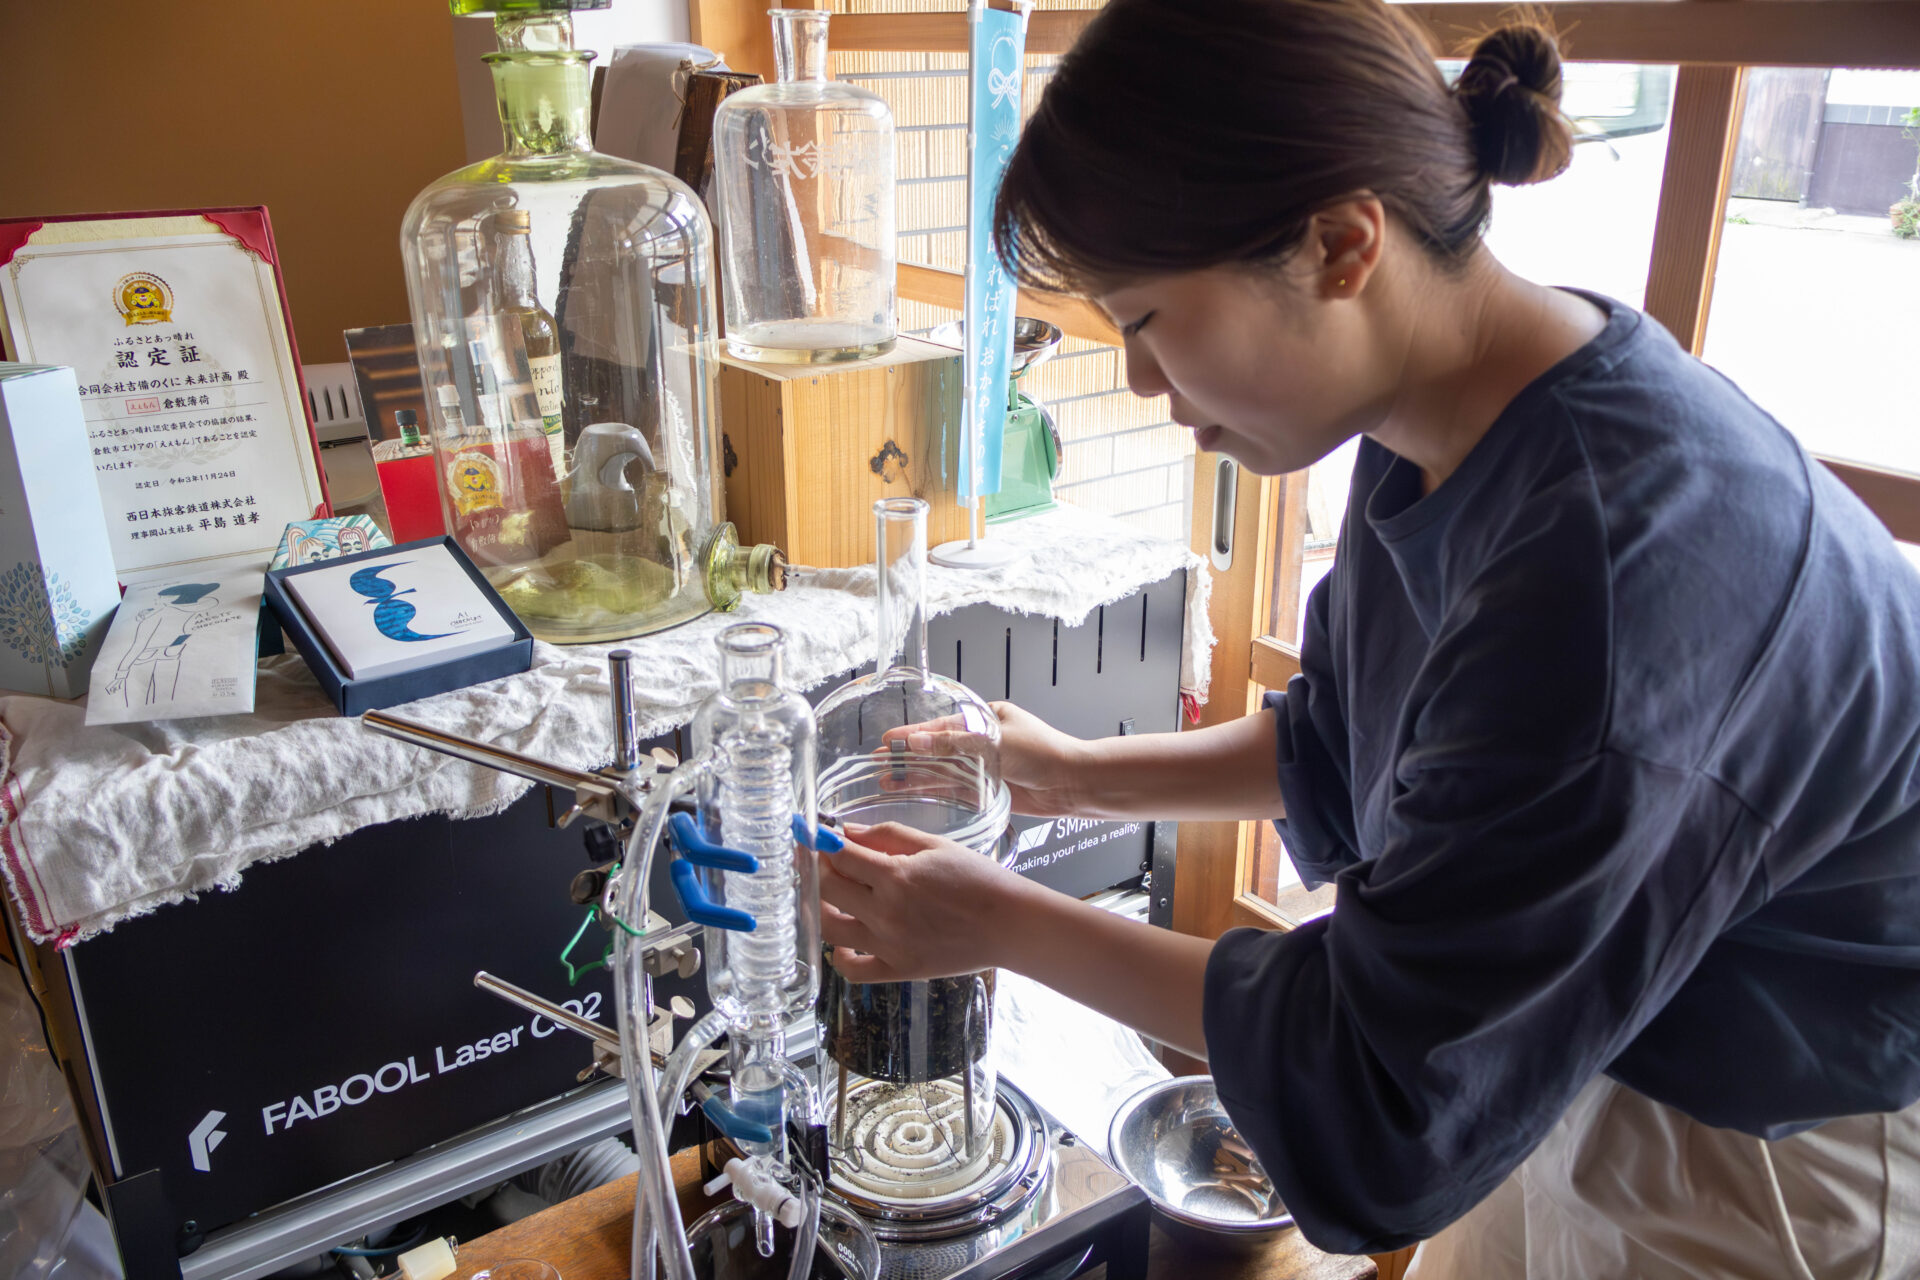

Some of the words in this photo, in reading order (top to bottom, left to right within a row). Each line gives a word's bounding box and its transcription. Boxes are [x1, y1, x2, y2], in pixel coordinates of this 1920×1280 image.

[114, 332, 193, 346] ふるさとあっ晴れ
[115, 345, 201, 368] 認定証
[163, 394, 210, 410] 倉敷薄荷
[126, 495, 257, 522] 西日本旅客鉄道株式会社
[1012, 853, 1050, 874] making
[1052, 844, 1076, 863] your
[1078, 836, 1099, 852] idea
[1101, 833, 1107, 843] a
[1109, 822, 1140, 840] reality.
[262, 1056, 430, 1136] FABOOL
[435, 1025, 525, 1075] Laser
[530, 991, 602, 1039] CO2
